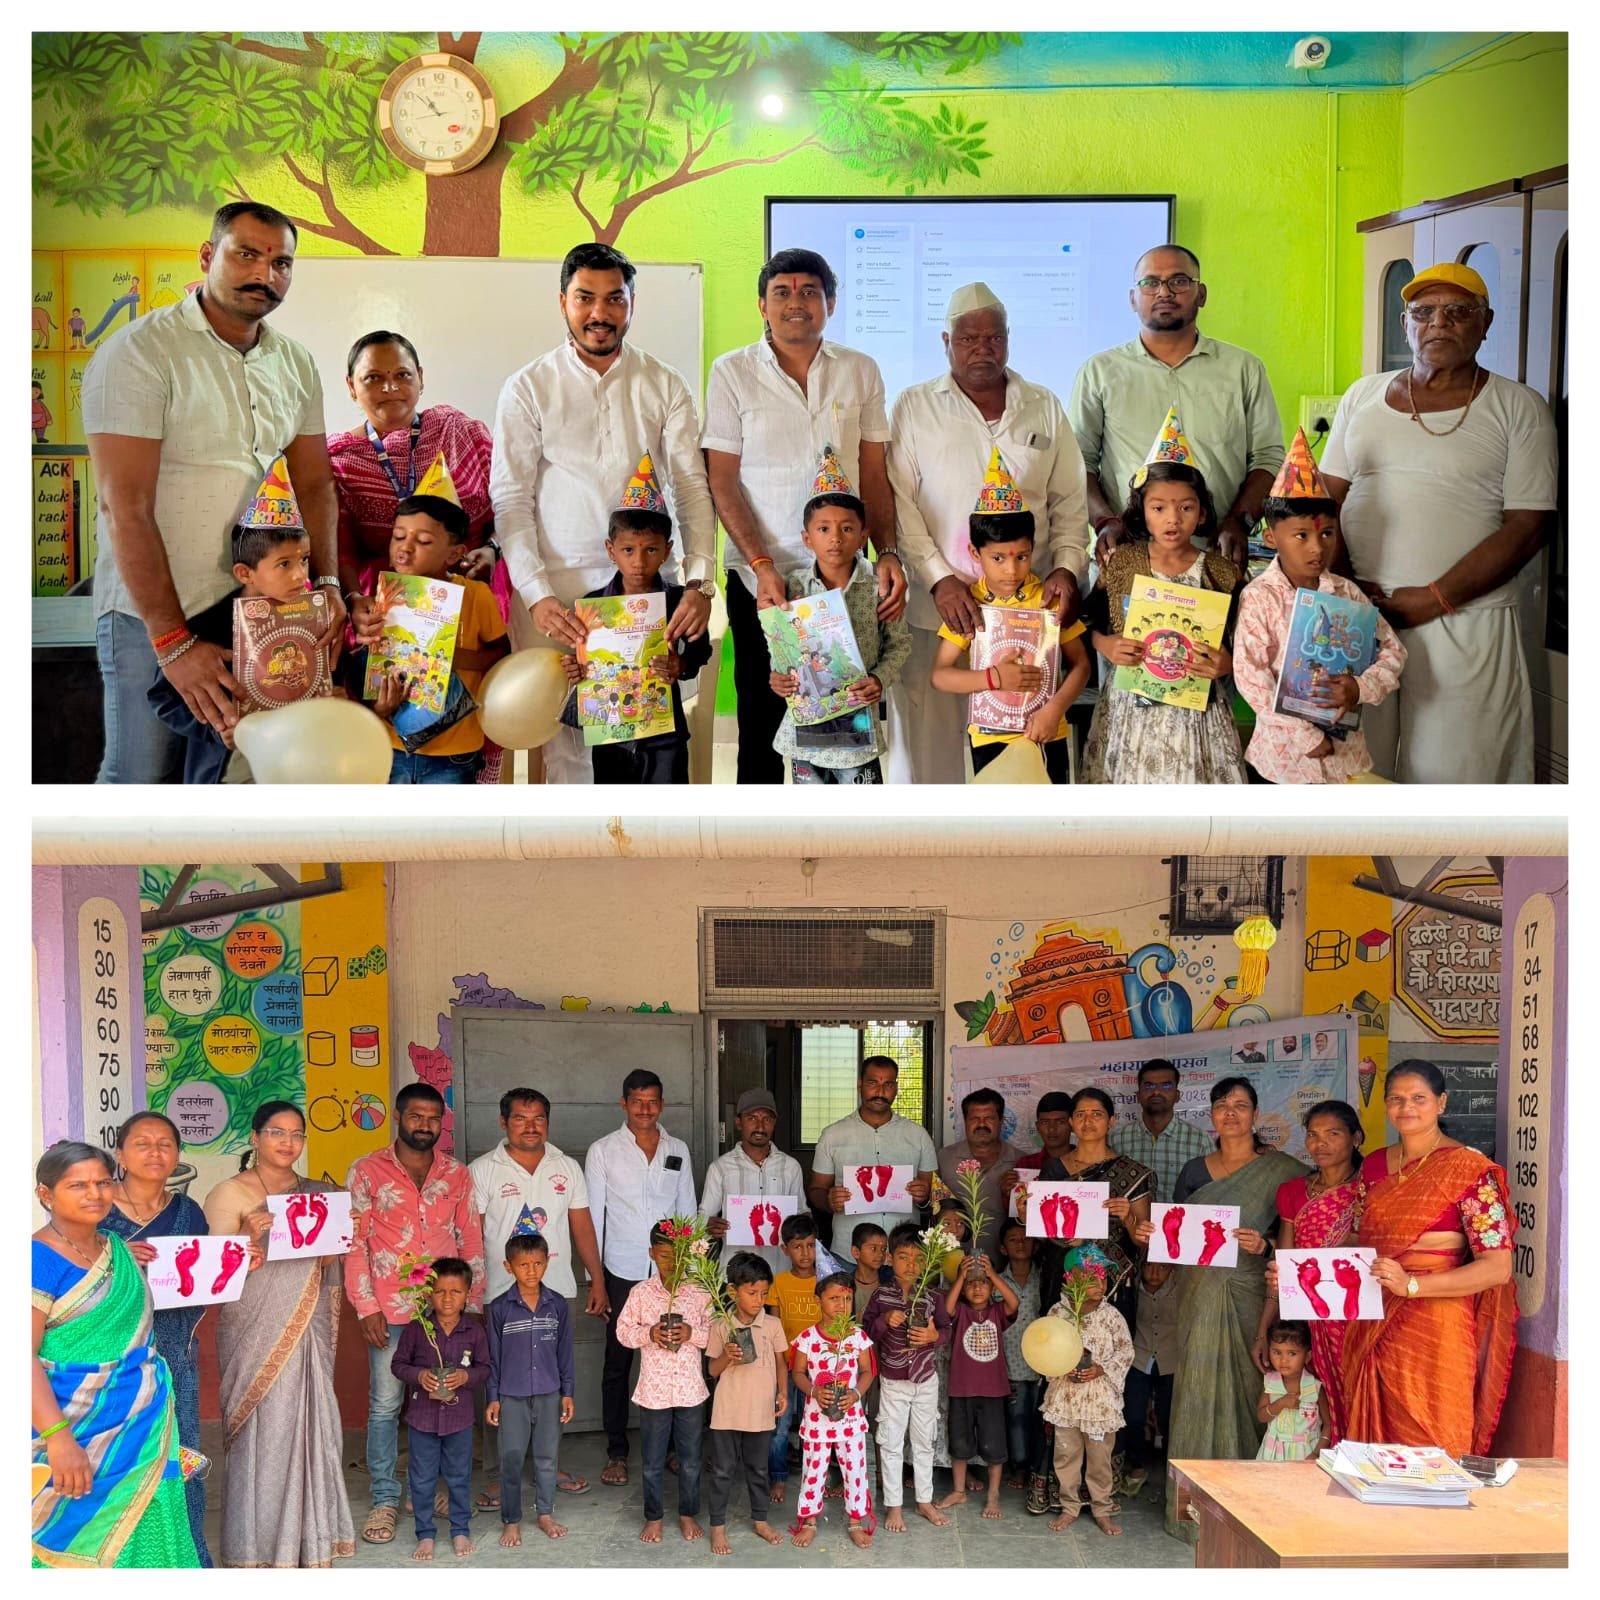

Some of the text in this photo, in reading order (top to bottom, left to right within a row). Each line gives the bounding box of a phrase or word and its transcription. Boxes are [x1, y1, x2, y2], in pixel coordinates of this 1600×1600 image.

[34, 291, 53, 302] tall
[40, 462, 70, 477] ACK
[39, 490, 69, 502] back
[39, 510, 68, 522] rack
[38, 533, 70, 546] pack
[38, 554, 70, 566] sack
[40, 576, 68, 588] tack
[94, 918, 112, 942] 15
[190, 921, 222, 936] करतो
[236, 931, 268, 942] घर व
[1524, 922, 1538, 949] 17
[226, 943, 258, 957] परिसर
[94, 950, 115, 978] 30
[240, 958, 266, 970] ठेवतो
[1524, 956, 1542, 986] 34
[96, 986, 118, 1010] 45
[168, 990, 190, 1004] हात
[1522, 994, 1538, 1018] 51
[97, 1018, 120, 1044] 60
[1522, 1025, 1538, 1050] 68
[232, 1042, 257, 1058] करतो
[98, 1053, 120, 1078] 75
[1100, 1060, 1142, 1073] महारा
[1522, 1058, 1538, 1084] 85
[100, 1087, 120, 1112] 90
[1518, 1093, 1538, 1118] 102
[1516, 1126, 1537, 1152] 119
[1516, 1161, 1538, 1188] 136
[1514, 1202, 1536, 1230] 153
[1514, 1245, 1534, 1278] 170
[788, 1302, 820, 1316] DUD
